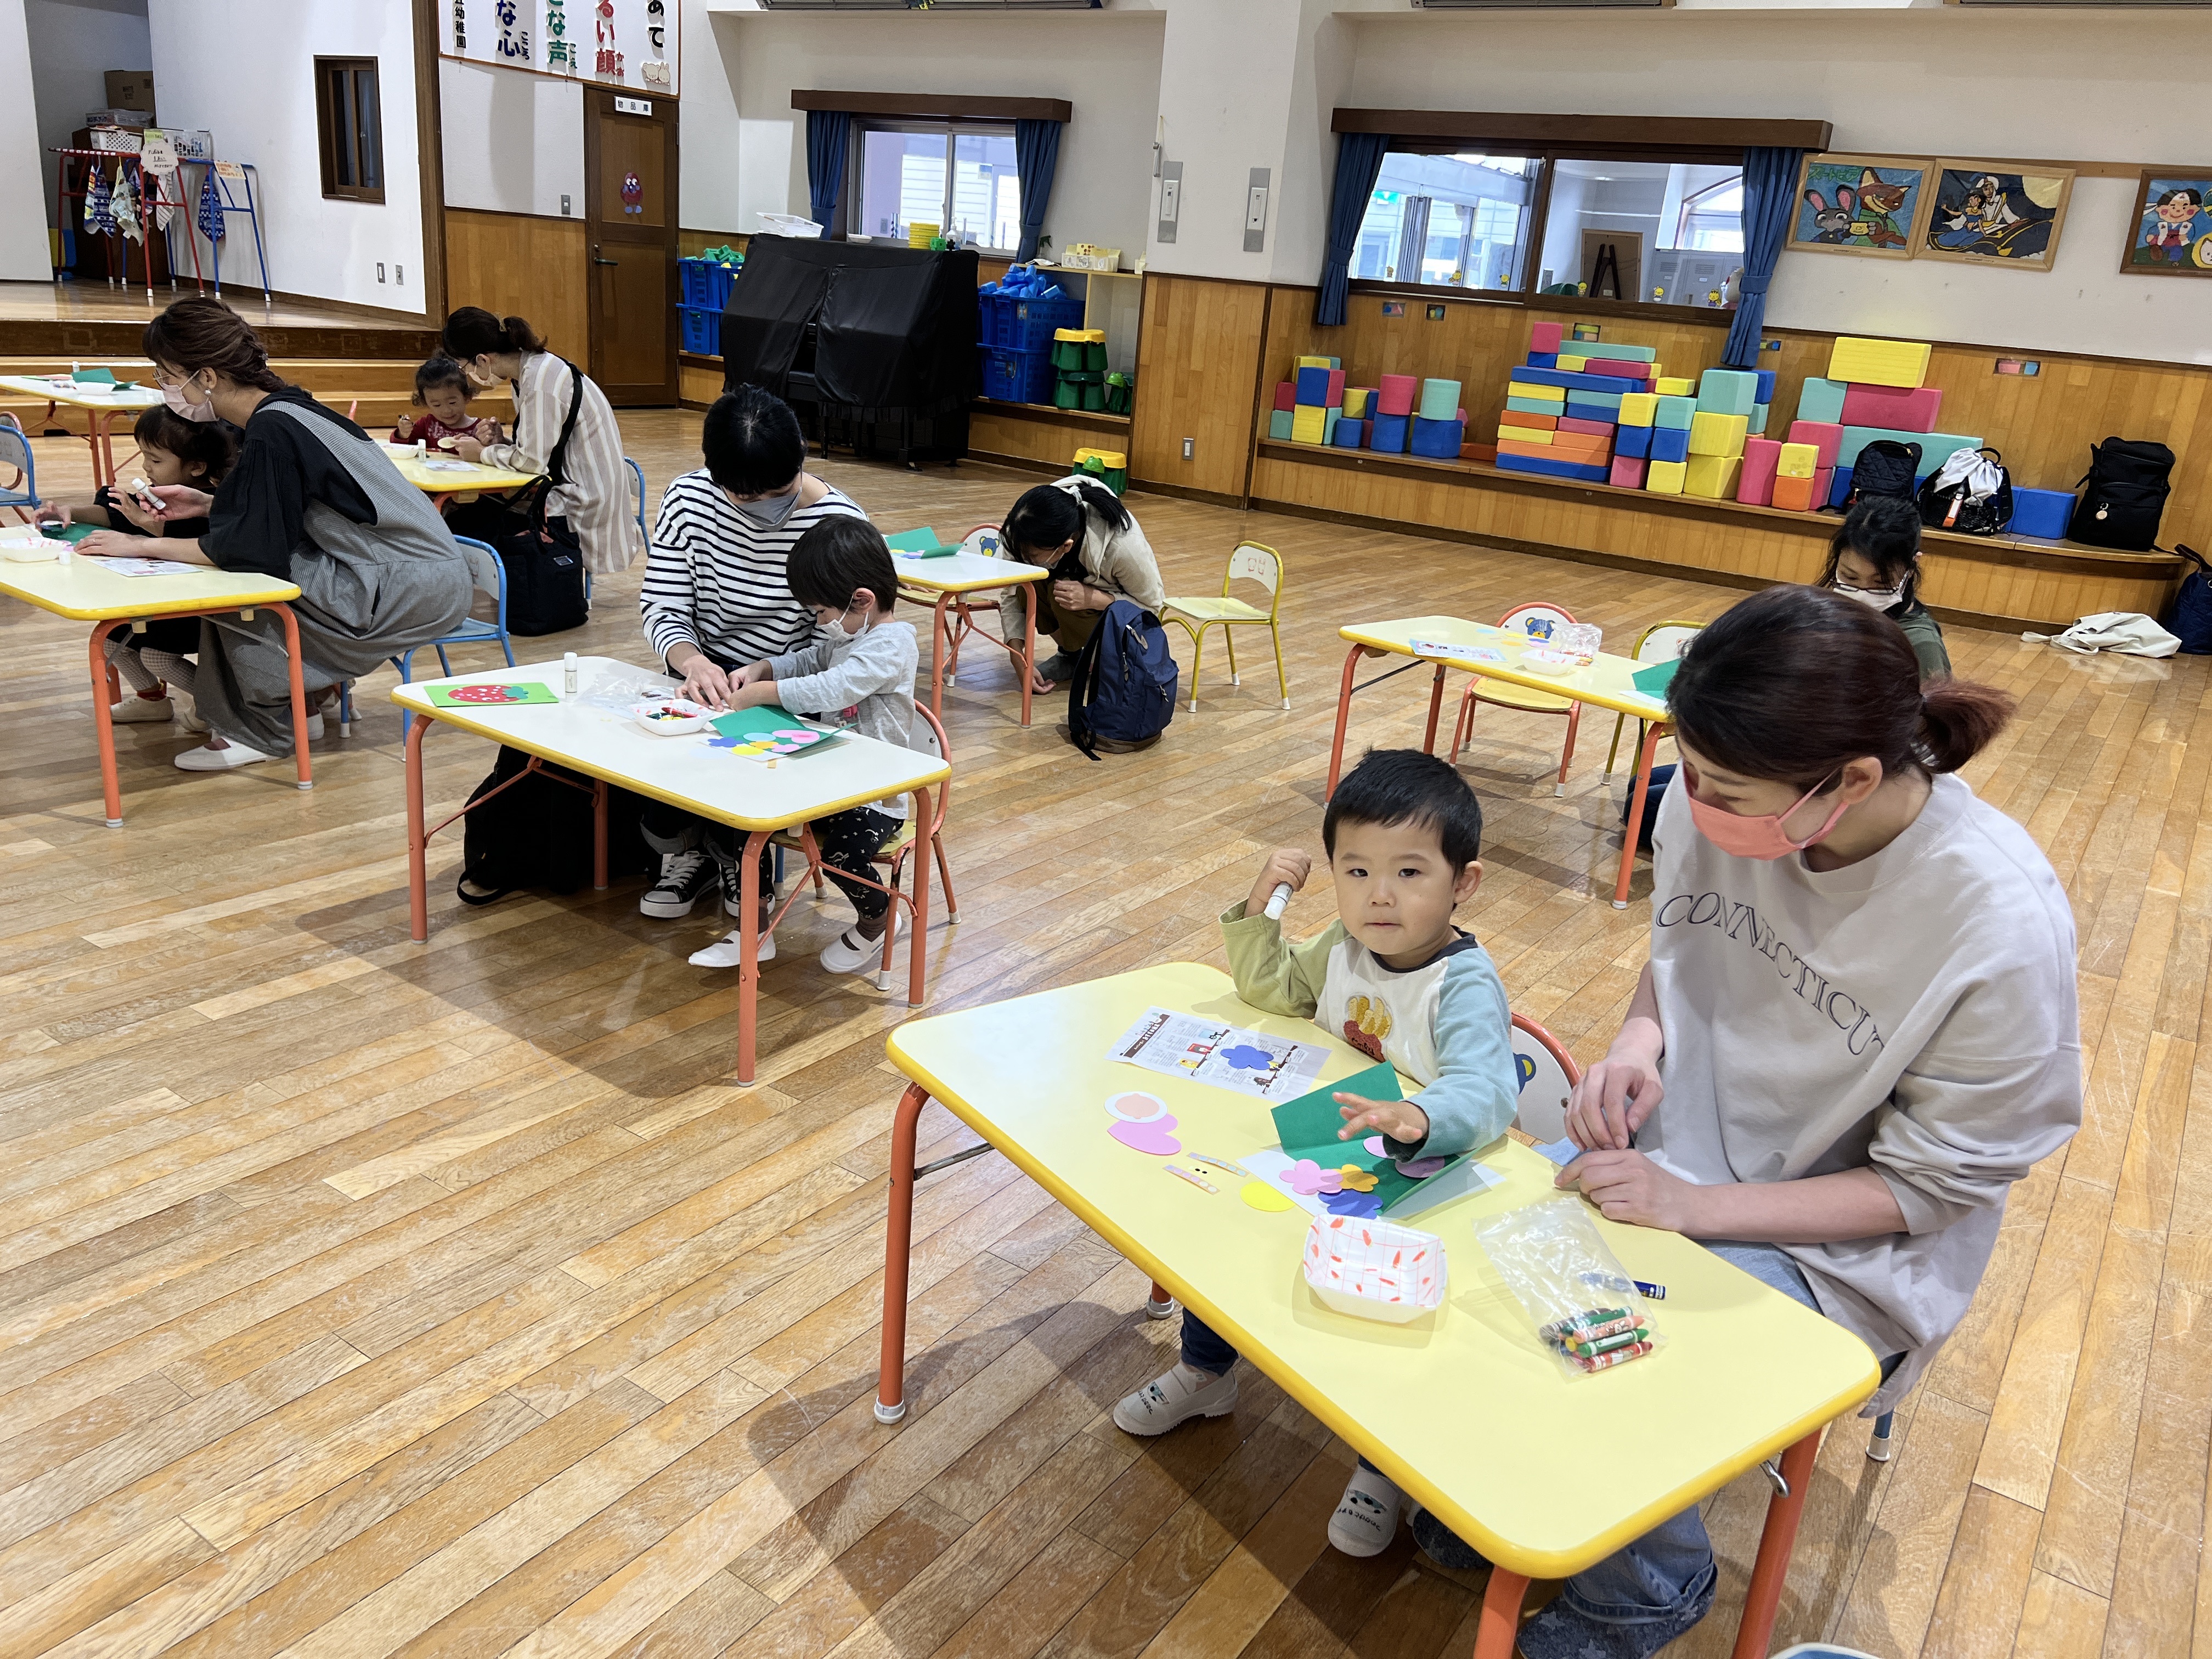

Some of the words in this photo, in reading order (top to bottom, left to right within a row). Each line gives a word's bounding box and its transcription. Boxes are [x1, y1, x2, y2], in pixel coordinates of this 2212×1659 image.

[521, 31, 530, 60] こころ
[569, 43, 578, 69] こえ
[616, 52, 624, 77] かお
